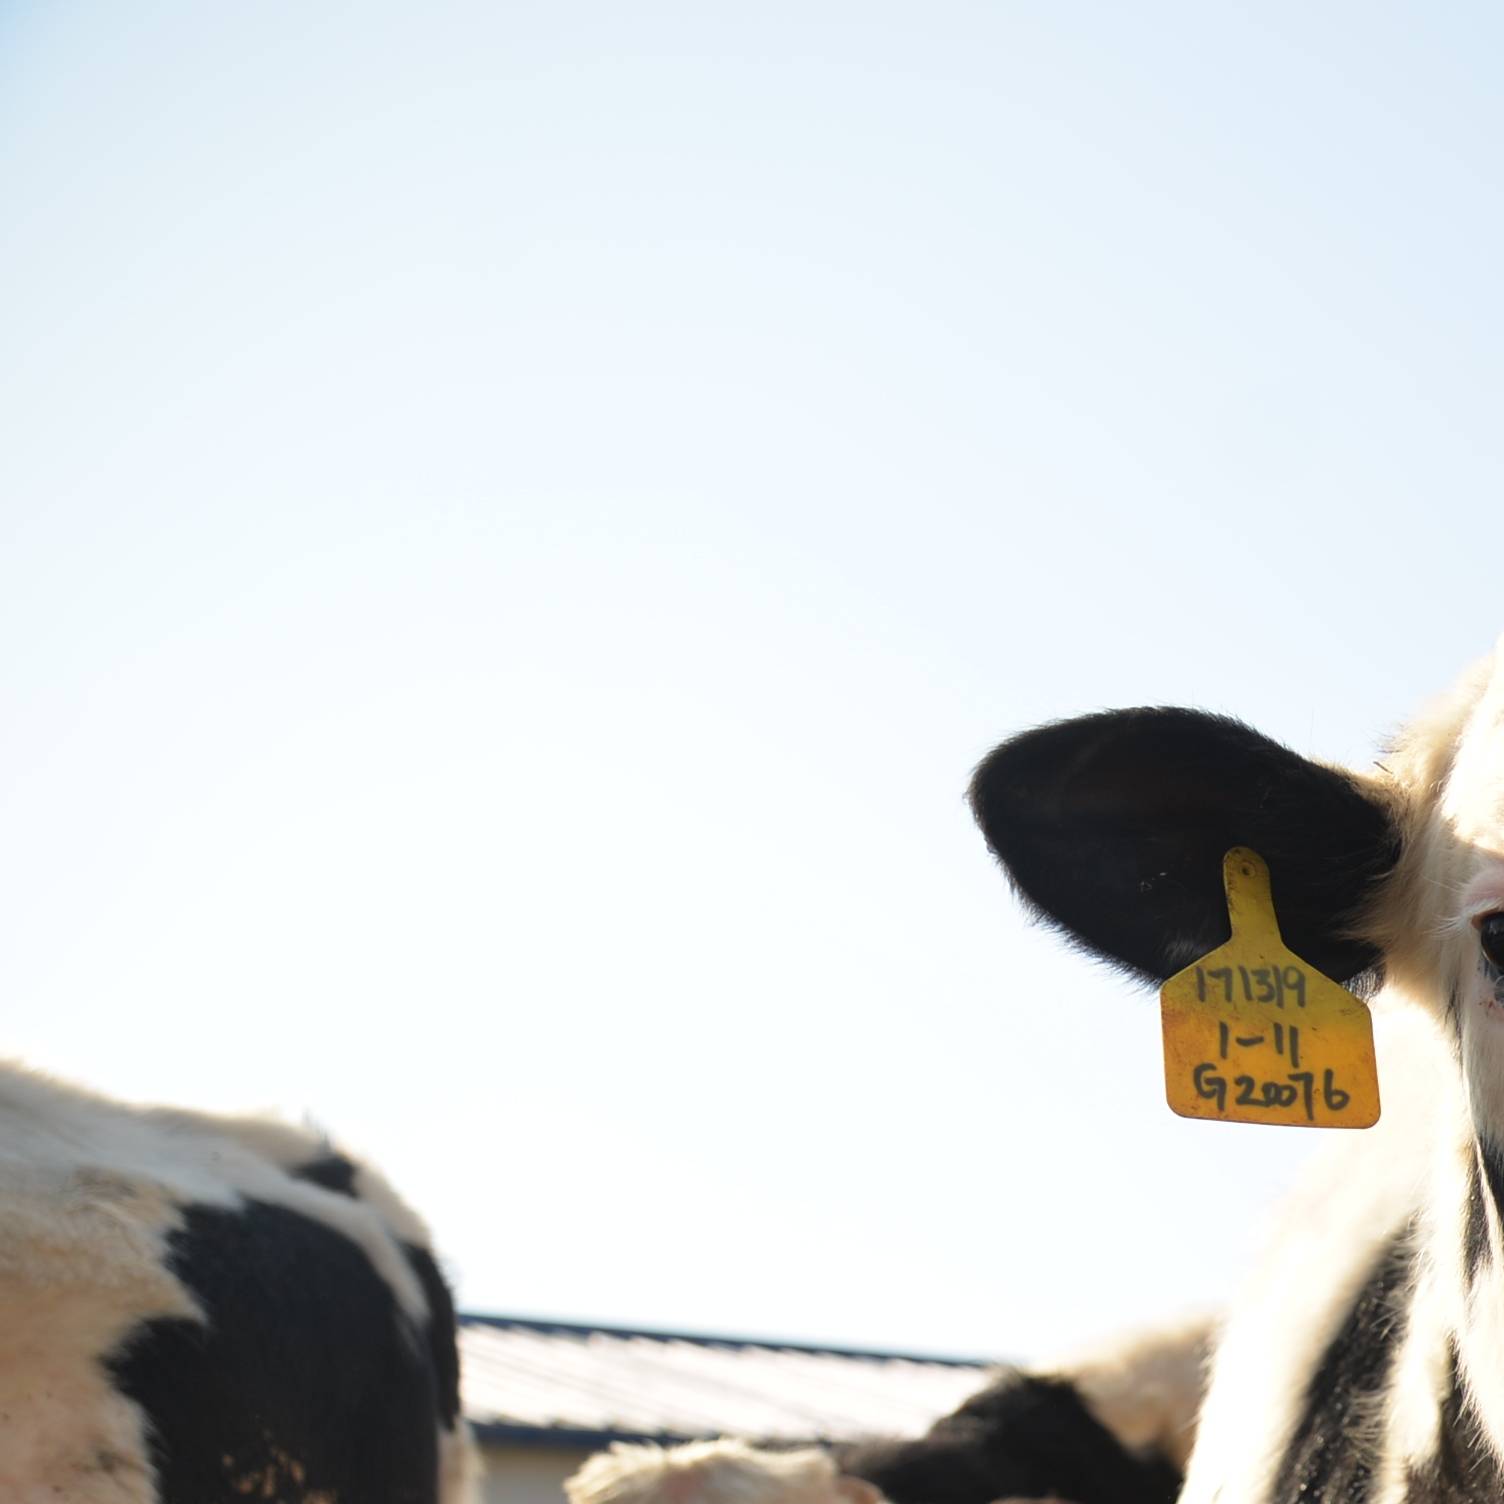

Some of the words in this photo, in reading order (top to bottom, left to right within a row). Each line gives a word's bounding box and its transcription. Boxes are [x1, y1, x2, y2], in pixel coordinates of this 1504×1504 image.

[1195, 964, 1306, 1008] 171319
[1219, 1021, 1300, 1068] 1-11
[1192, 1062, 1350, 1121] G20076
